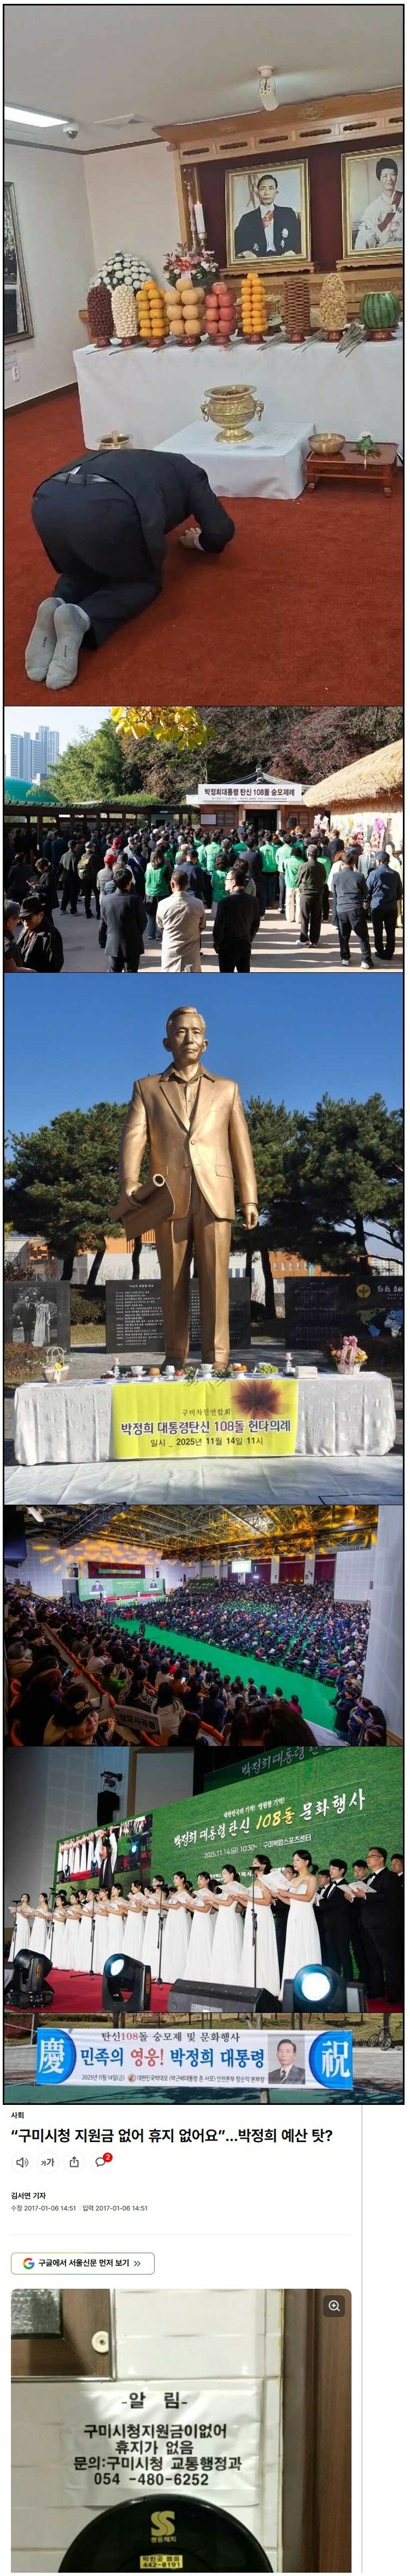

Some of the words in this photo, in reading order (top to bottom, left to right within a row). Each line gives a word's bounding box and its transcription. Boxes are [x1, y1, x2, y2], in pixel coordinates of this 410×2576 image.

[182, 1408, 231, 1416] 구미차인연합회
[121, 1422, 154, 1436] 박정희
[157, 1421, 209, 1435] 대통령탄신
[214, 1421, 244, 1433] 108돌
[248, 1420, 291, 1433] 헌다의례
[150, 1439, 166, 1447] 일시
[176, 1438, 202, 1447] 2025년
[206, 1437, 222, 1446] 11월
[226, 1437, 242, 1446] 14일
[224, 1807, 244, 1818] 대한민국의
[258, 1800, 272, 1811] 영원한
[273, 1797, 285, 1806] 기억!
[174, 1830, 197, 1848] 박정희
[200, 1823, 225, 1842] 대통령
[229, 1817, 250, 1836] 탄신
[256, 1807, 296, 1830] 108돌
[299, 1788, 366, 1820] 문화행사
[263, 1834, 312, 1849] 구미복합스포츠센터
[102, 2032, 148, 2042] 탄신108돌
[153, 2032, 182, 2042] 숭모제
[187, 2032, 195, 2042] 및
[200, 2032, 241, 2043] 문화행사
[38, 2037, 65, 2074] 慶
[80, 2047, 124, 2067] 민족의
[131, 2047, 163, 2067] 영웅!
[169, 2047, 213, 2068] 박정희
[220, 2048, 264, 2068] 대통령
[321, 2040, 350, 2078] 祝
[11, 2128, 70, 2143] “구미시청
[75, 2128, 114, 2143] 지원금
[118, 2128, 144, 2143] 없어
[148, 2128, 174, 2143] 휴지
[282, 2128, 308, 2143] 예산
[312, 2128, 333, 2143] 탓?
[40, 2158, 55, 2167] 가가
[39, 2259, 67, 2267] 구글에서
[69, 2259, 97, 2267] 서울신문
[99, 2259, 113, 2267] 먼저
[115, 2259, 129, 2267] 보기
[84, 2424, 227, 2439] 구미시청지원금이없어
[115, 2440, 159, 2455] 휴지가
[166, 2440, 194, 2455] 없음
[73, 2456, 163, 2471] 문의:구미시청
[171, 2456, 242, 2471] 교통행정과
[93, 2473, 120, 2485] 054
[129, 2473, 209, 2486] -480-6252
